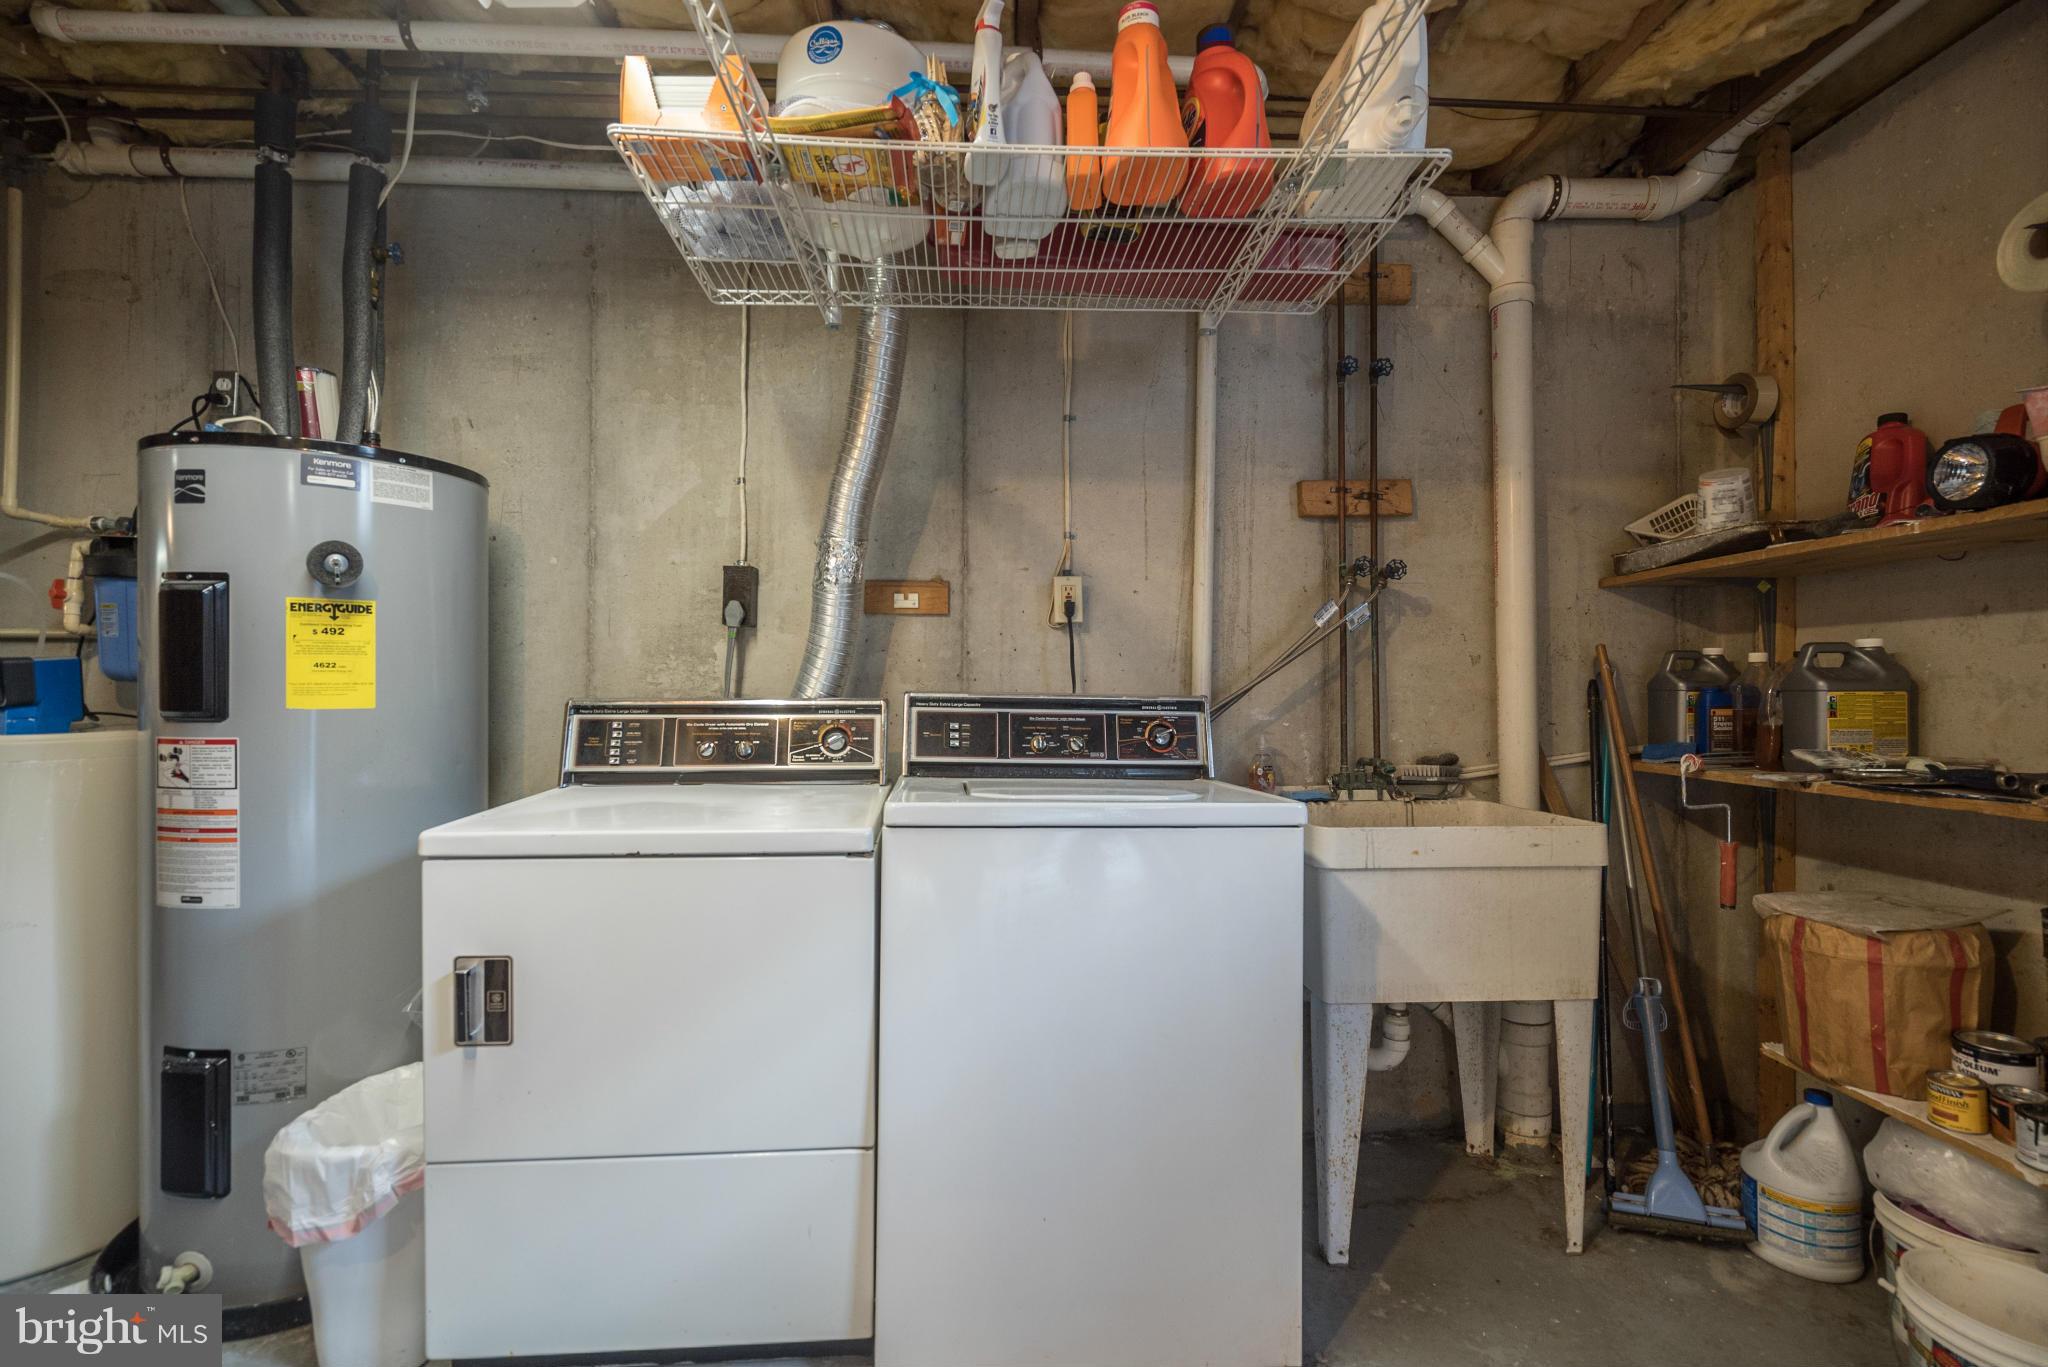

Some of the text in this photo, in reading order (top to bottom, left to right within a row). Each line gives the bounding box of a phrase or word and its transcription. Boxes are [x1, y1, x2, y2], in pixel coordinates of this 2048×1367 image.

[313, 457, 352, 469] Kenmore
[290, 602, 373, 615] ENERGYGUIDE
[321, 627, 345, 636] 492
